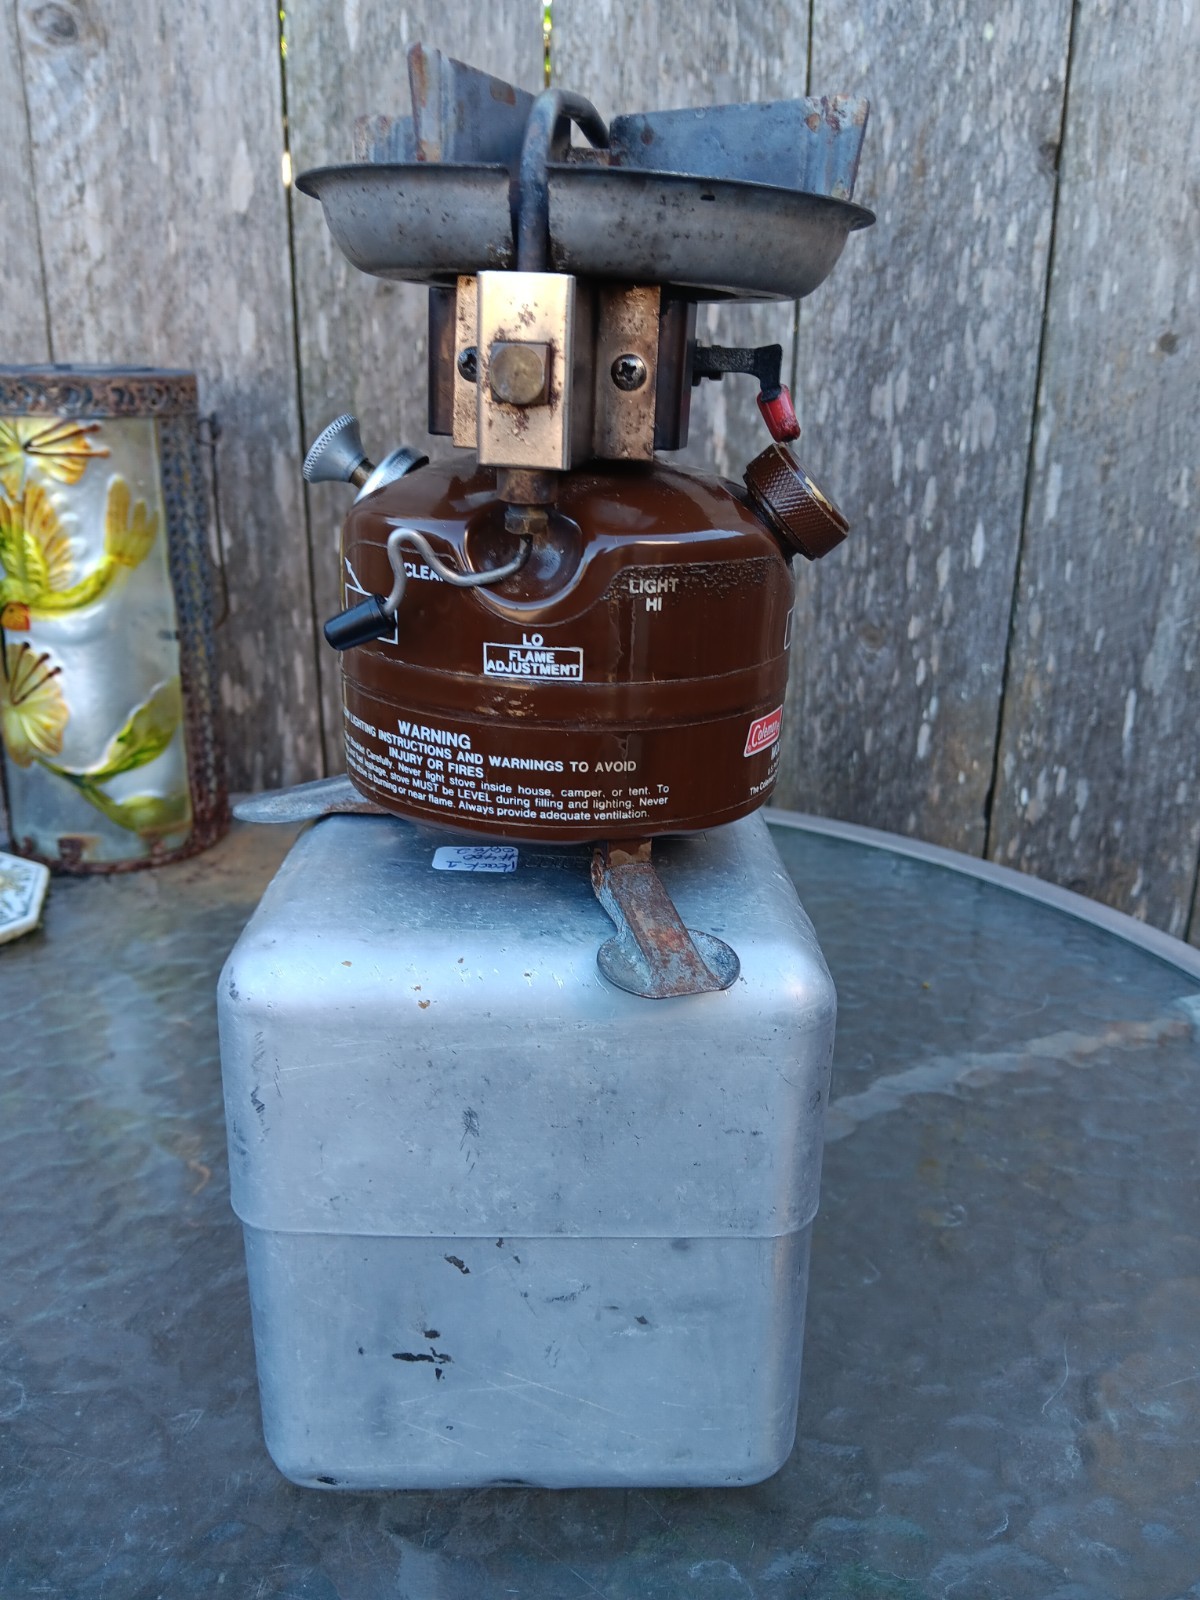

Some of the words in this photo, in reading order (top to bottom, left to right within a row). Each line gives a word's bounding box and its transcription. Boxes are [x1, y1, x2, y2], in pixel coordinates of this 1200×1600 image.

[403, 562, 444, 582] CLEA
[629, 578, 679, 594] LIGHT
[646, 597, 662, 612] HI
[522, 633, 544, 647] LO
[486, 660, 580, 676] ADJUSTMENT
[508, 650, 555, 664] FLAME
[398, 720, 472, 750] WARNING
[378, 729, 452, 760] INSTRUCTIONS
[456, 751, 484, 765] AND
[488, 755, 564, 772] WARNINGS
[569, 761, 589, 773] TO
[595, 761, 637, 773] AVOID
[388, 746, 424, 766] INJURY
[427, 758, 444, 771] OR
[448, 762, 484, 778] FIRES
[389, 772, 410, 785] stove
[412, 778, 439, 792] MUST
[442, 785, 454, 796] be
[457, 788, 492, 803] LEVEL
[496, 794, 530, 808] during
[534, 797, 564, 810] filling
[568, 799, 588, 809] and
[593, 798, 635, 811] lighting.
[639, 795, 669, 807] Never
[398, 763, 422, 777] Never
[425, 770, 445, 783] light
[449, 777, 476, 789] stove
[480, 781, 512, 794] inside
[518, 785, 555, 798] house,
[560, 789, 606, 799] camper,
[612, 789, 623, 797] or
[628, 786, 651, 796] tent.
[657, 784, 670, 794] To
[398, 786, 406, 795] or
[408, 789, 427, 801] near
[428, 793, 456, 808] flame.
[458, 802, 495, 816] Always
[497, 807, 537, 819] provide
[539, 811, 591, 821] adequate
[594, 810, 650, 820] ventilation.
